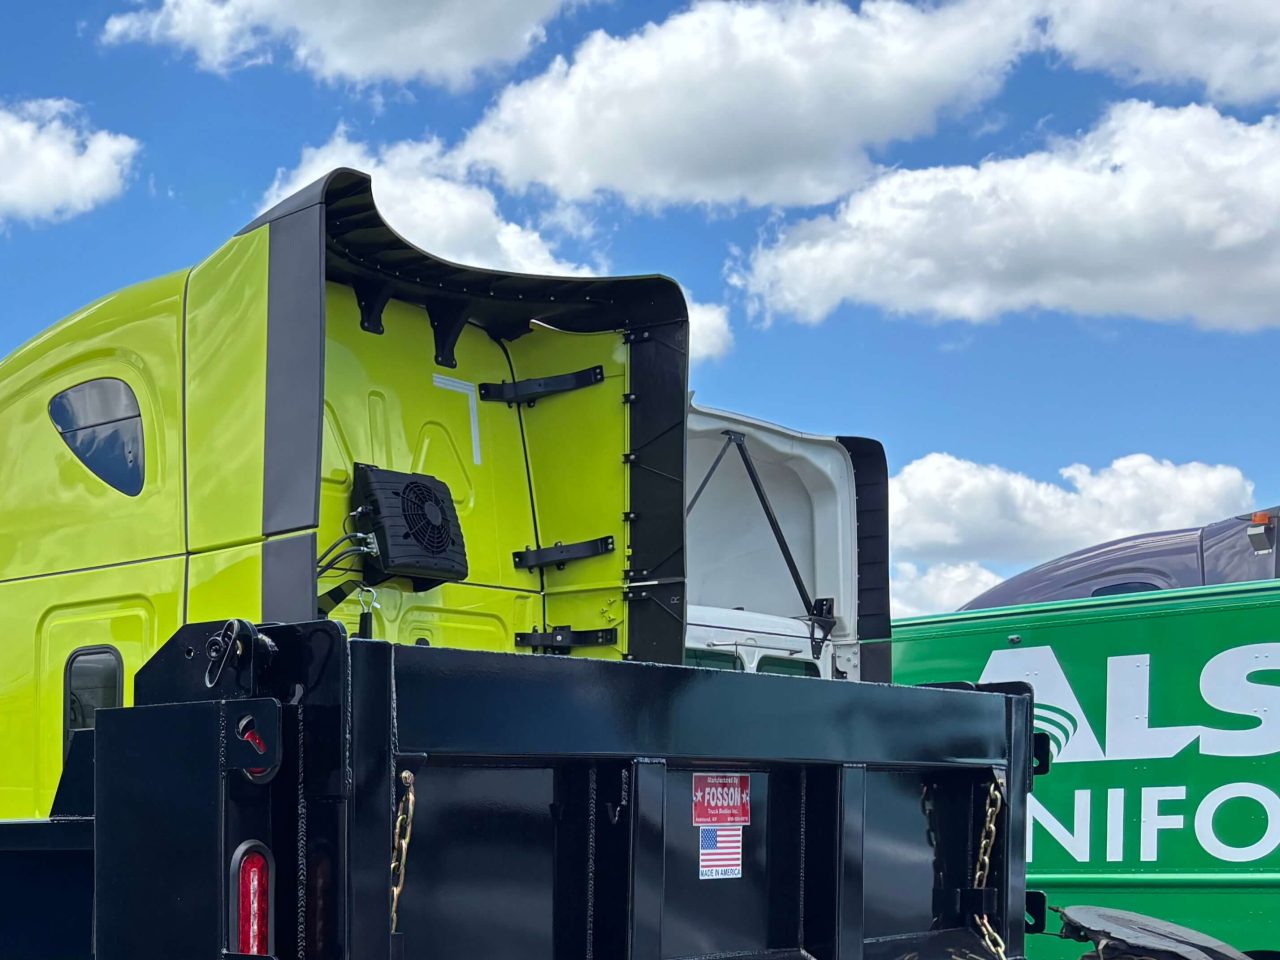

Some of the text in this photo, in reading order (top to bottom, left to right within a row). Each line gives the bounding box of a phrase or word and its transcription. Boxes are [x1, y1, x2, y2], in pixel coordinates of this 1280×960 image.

[704, 786, 741, 807] FOSSON
[1025, 782, 1280, 863] NIFO
[700, 867, 741, 877] MADE IN AMERICA
